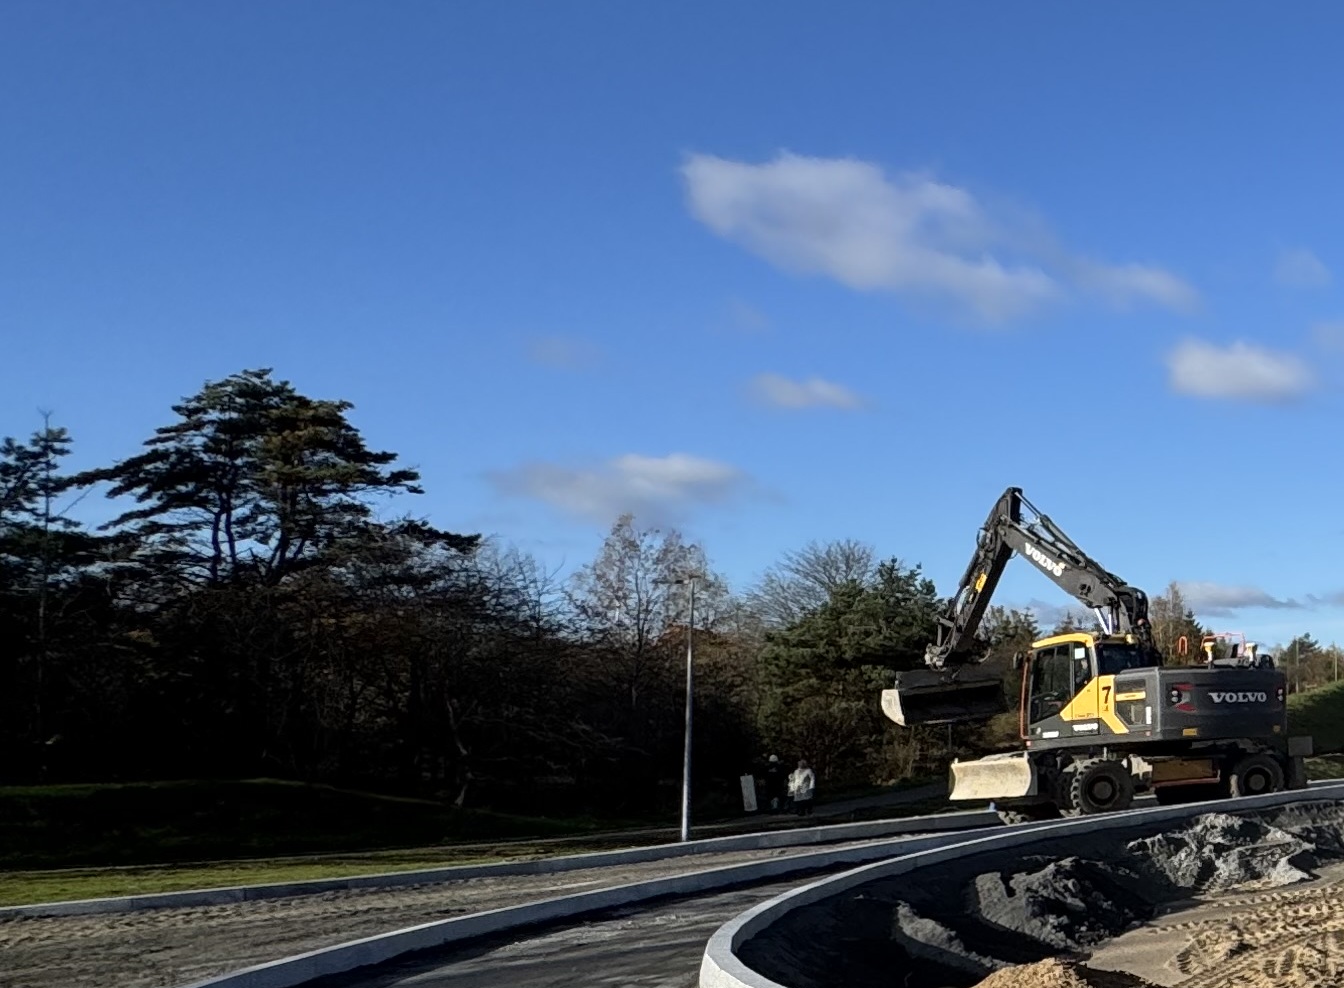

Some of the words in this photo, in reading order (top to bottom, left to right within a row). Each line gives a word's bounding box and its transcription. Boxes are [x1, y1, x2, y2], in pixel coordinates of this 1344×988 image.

[1025, 542, 1062, 577] VOLVO
[1102, 685, 1111, 704] 7
[1207, 692, 1267, 703] VOLVO
